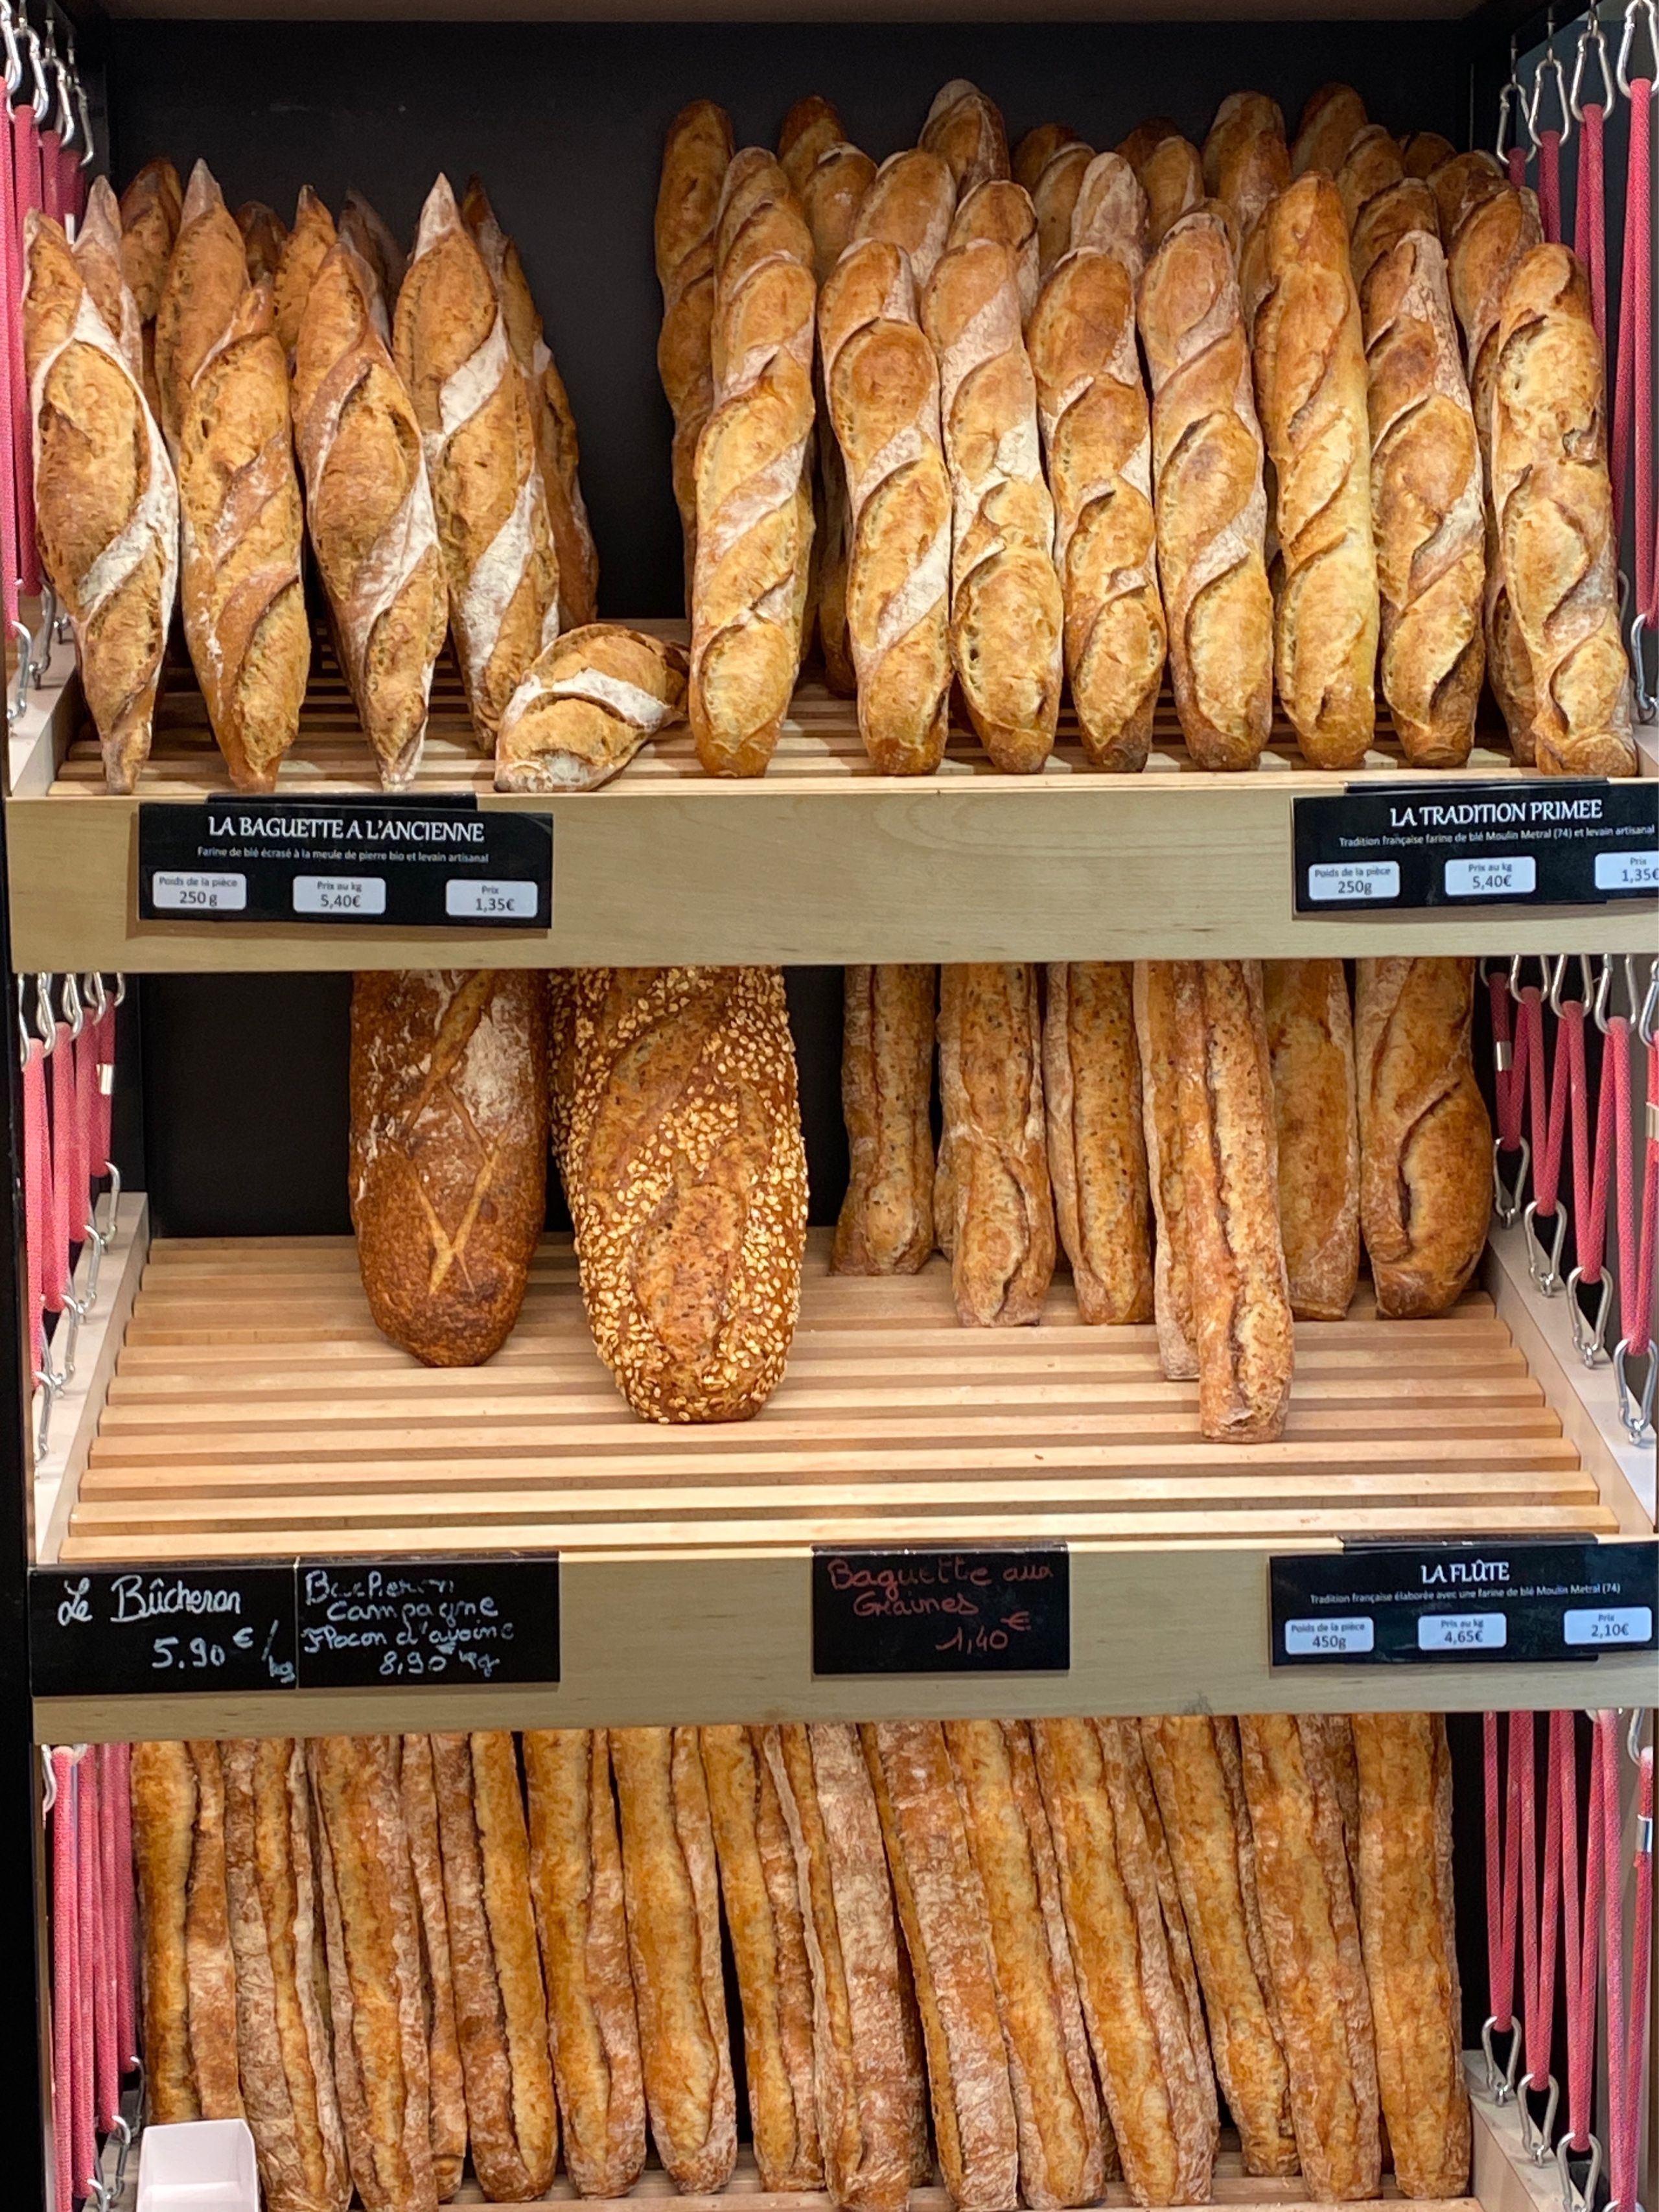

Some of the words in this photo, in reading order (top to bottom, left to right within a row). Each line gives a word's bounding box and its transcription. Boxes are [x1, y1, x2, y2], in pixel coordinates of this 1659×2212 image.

[1390, 807, 1417, 827] LA
[1419, 802, 1526, 826] TRADITION
[1530, 799, 1603, 821] PRIMEE
[208, 816, 237, 836] LA
[238, 817, 344, 838] BAGUETTE
[346, 820, 363, 839] A
[1339, 835, 1380, 847] Tradition
[1382, 833, 1424, 846] française
[1426, 833, 1453, 844] farine
[1454, 832, 1467, 843] de
[1468, 832, 1483, 842] blé
[1485, 830, 1518, 841] Moulin
[1520, 828, 1551, 839] Metral
[1553, 828, 1572, 840] (74)
[1574, 828, 1584, 837] et
[1586, 826, 1614, 837] levain
[1615, 824, 1655, 836] artisanal
[197, 846, 227, 856] Farine
[229, 846, 242, 857] de
[244, 847, 259, 857] blé
[261, 847, 292, 858] écrasé
[294, 848, 300, 859] à
[301, 848, 310, 859] la
[312, 849, 342, 860] meule
[345, 850, 357, 860] de
[358, 850, 387, 862] pierre
[389, 850, 404, 861] bio
[406, 852, 417, 861] et
[418, 851, 447, 862] levain
[448, 852, 489, 863] artisanal
[1630, 857, 1647, 866] Prix
[1468, 863, 1485, 872] Prix
[1502, 862, 1513, 872] kg
[317, 881, 335, 890] Prix
[337, 882, 349, 891] au
[351, 881, 362, 892] kg
[481, 885, 499, 894] Prix
[1338, 880, 1372, 895] 250g
[1472, 875, 1512, 891] 5,40€
[180, 891, 206, 904] 250
[209, 894, 218, 907] g
[320, 894, 361, 909] 5,40€
[475, 898, 515, 913] 1,35€
[1421, 1564, 1447, 1584] LA
[1449, 1559, 1510, 1583] FLÛTE
[58, 1577, 93, 1626] Le
[1310, 1594, 1350, 1604] Tradition
[1352, 1592, 1393, 1604] française
[1394, 1590, 1434, 1601] élaborée
[1436, 1590, 1457, 1600] avec
[1459, 1590, 1476, 1599] une
[1478, 1588, 1505, 1598] farine
[1506, 1587, 1519, 1597] de
[1520, 1586, 1535, 1596] blé
[1537, 1585, 1568, 1596] Moulin
[1570, 1583, 1601, 1594] Metral
[1602, 1583, 1621, 1594] (74)
[1441, 1619, 1457, 1628] Prix
[1473, 1618, 1483, 1628] kg
[1598, 1613, 1615, 1622] Prix
[1444, 1629, 1483, 1645] 4,65€
[1591, 1622, 1629, 1639] 2,10€
[1312, 1635, 1346, 1651] 450g
